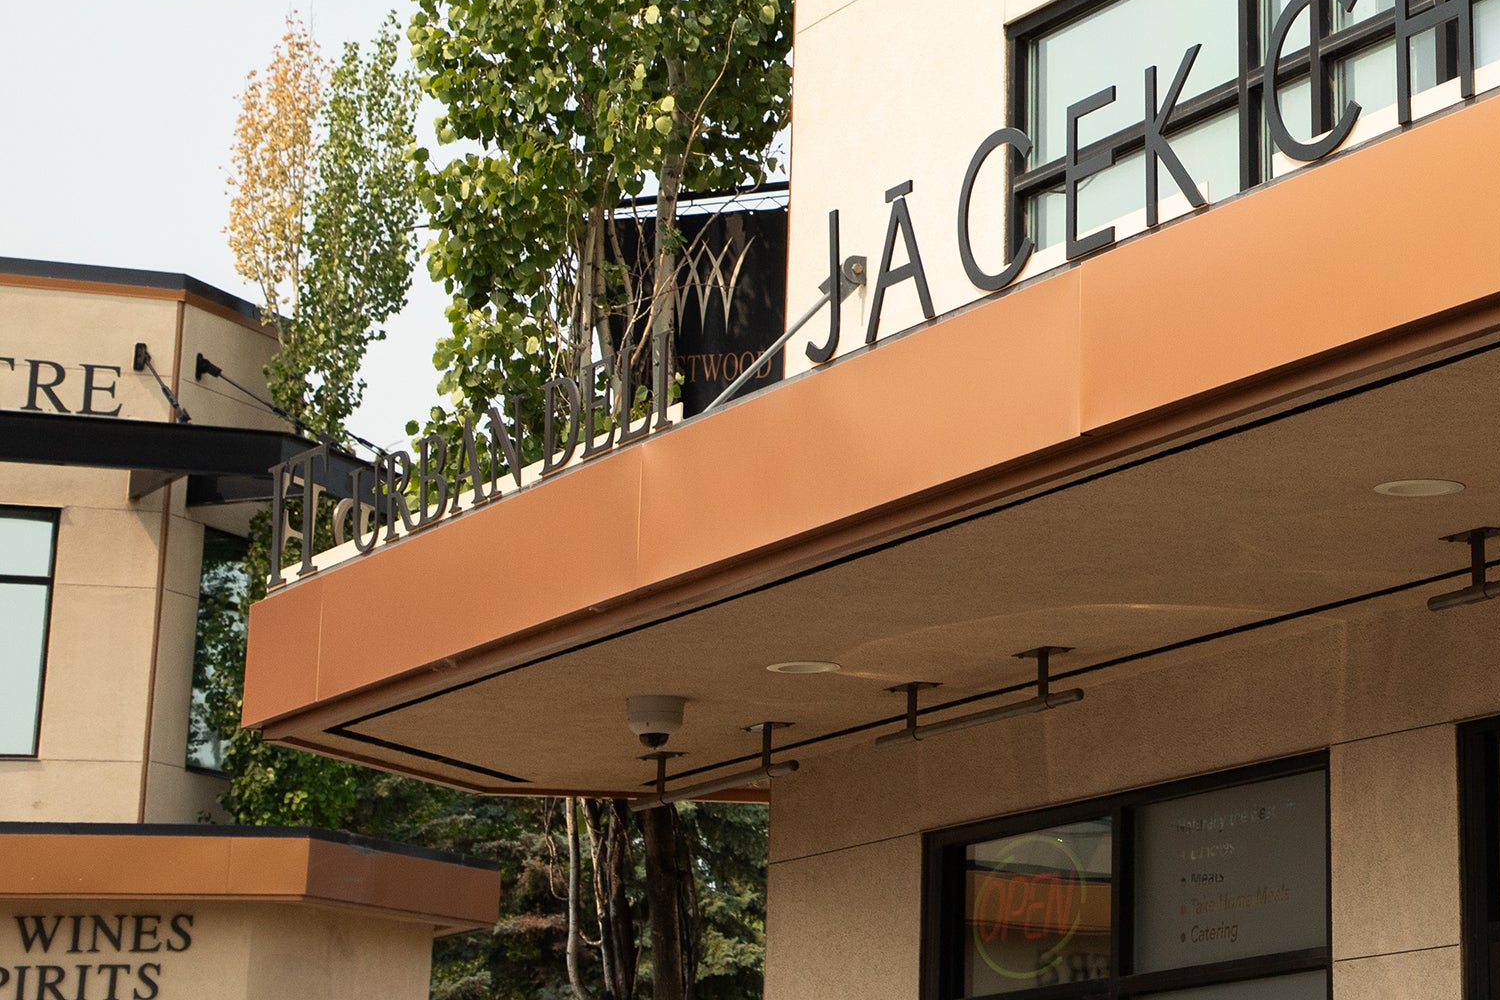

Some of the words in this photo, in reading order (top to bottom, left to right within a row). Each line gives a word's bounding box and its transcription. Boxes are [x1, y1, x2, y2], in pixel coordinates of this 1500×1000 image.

[349, 393, 525, 554] URBAN
[539, 329, 675, 477] DELI
[14, 914, 194, 953] WINES
[978, 870, 1077, 943] OPEN
[1190, 921, 1239, 944] Catering
